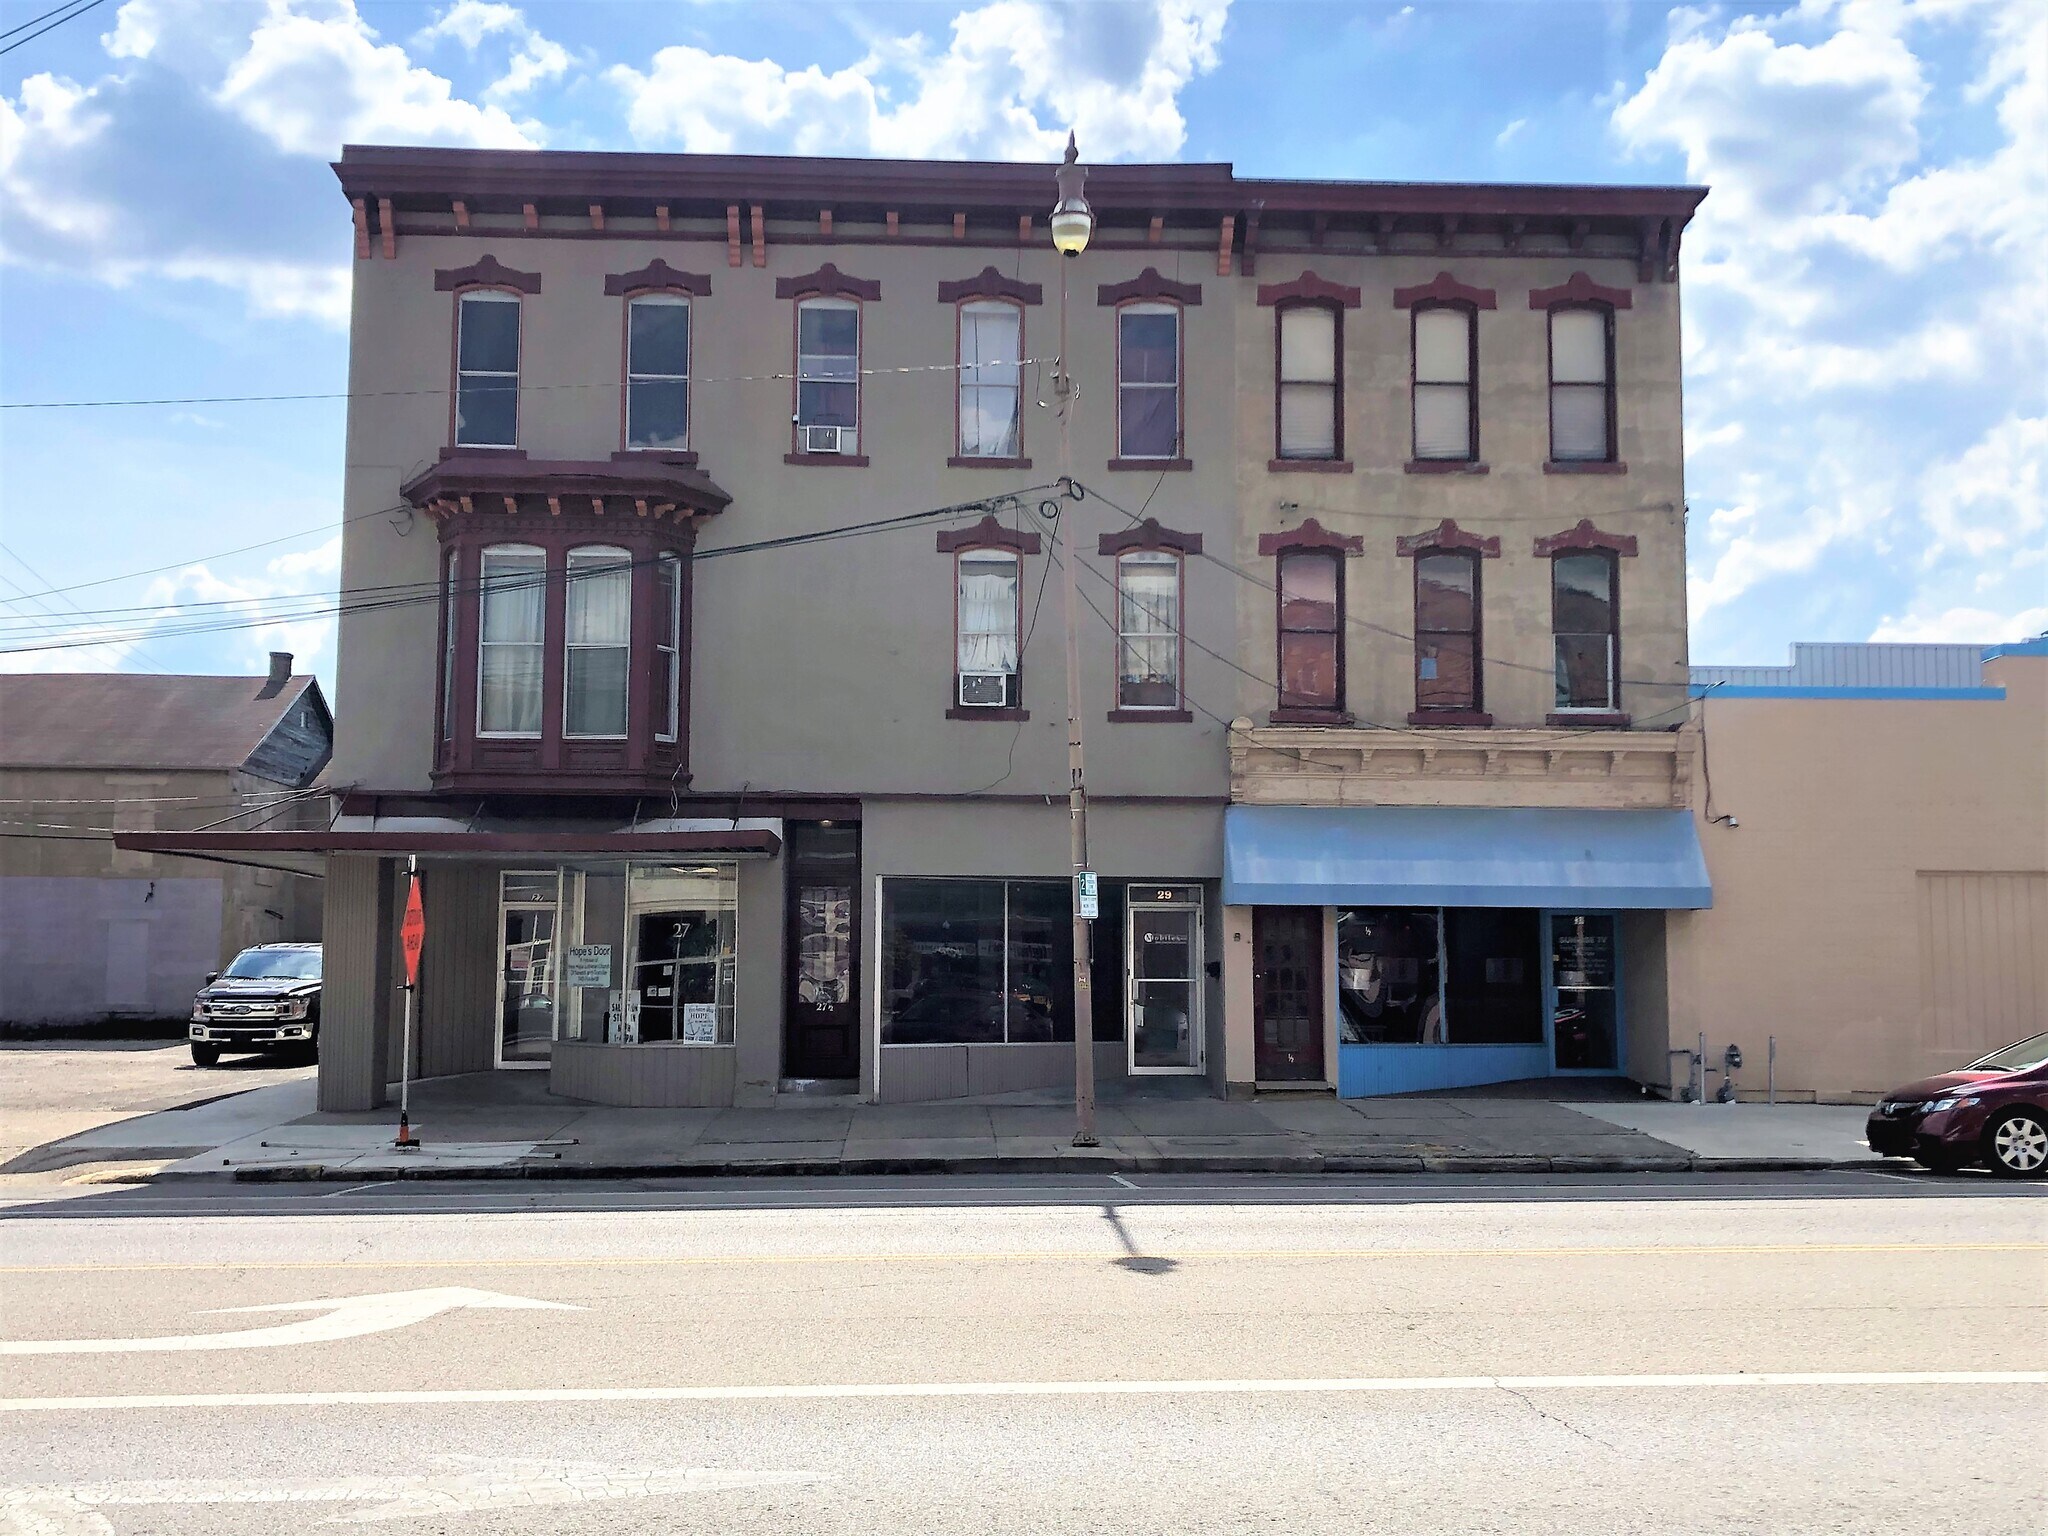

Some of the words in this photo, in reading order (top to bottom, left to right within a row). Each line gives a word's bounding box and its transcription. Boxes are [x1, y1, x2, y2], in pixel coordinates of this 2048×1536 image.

[1157, 890, 1172, 900] 29
[673, 923, 691, 938] 27
[569, 946, 592, 958] Hope's
[593, 945, 611, 956] Door
[618, 993, 631, 1002] FE
